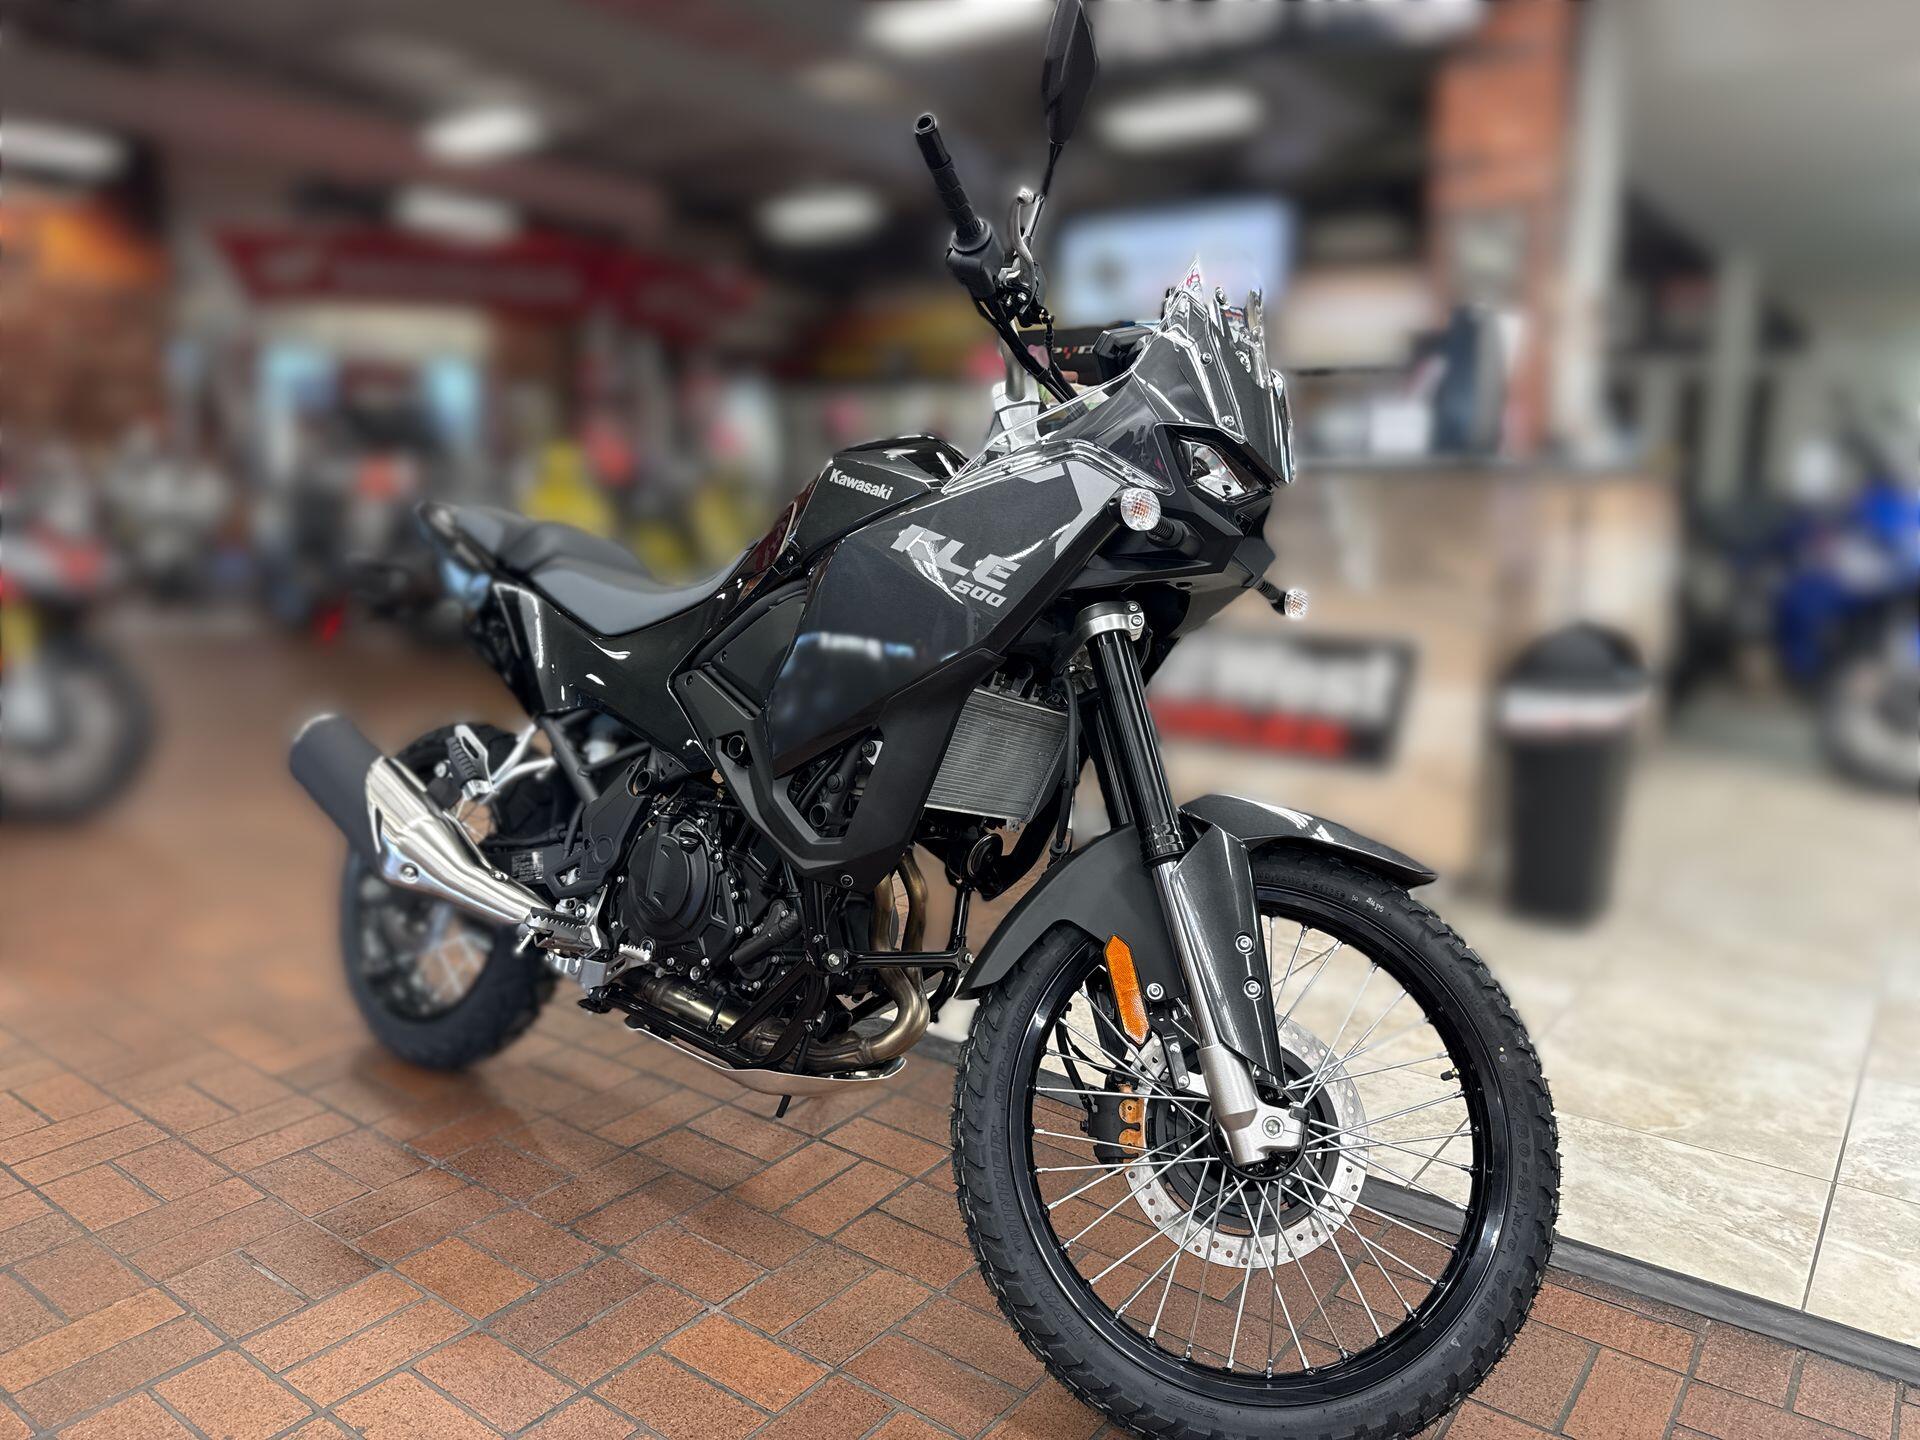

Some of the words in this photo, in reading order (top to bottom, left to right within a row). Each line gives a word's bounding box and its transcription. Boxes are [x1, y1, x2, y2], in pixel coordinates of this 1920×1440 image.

[829, 468, 894, 501] Kawasaki
[891, 524, 1021, 590] KLE
[951, 579, 1007, 608] 500
